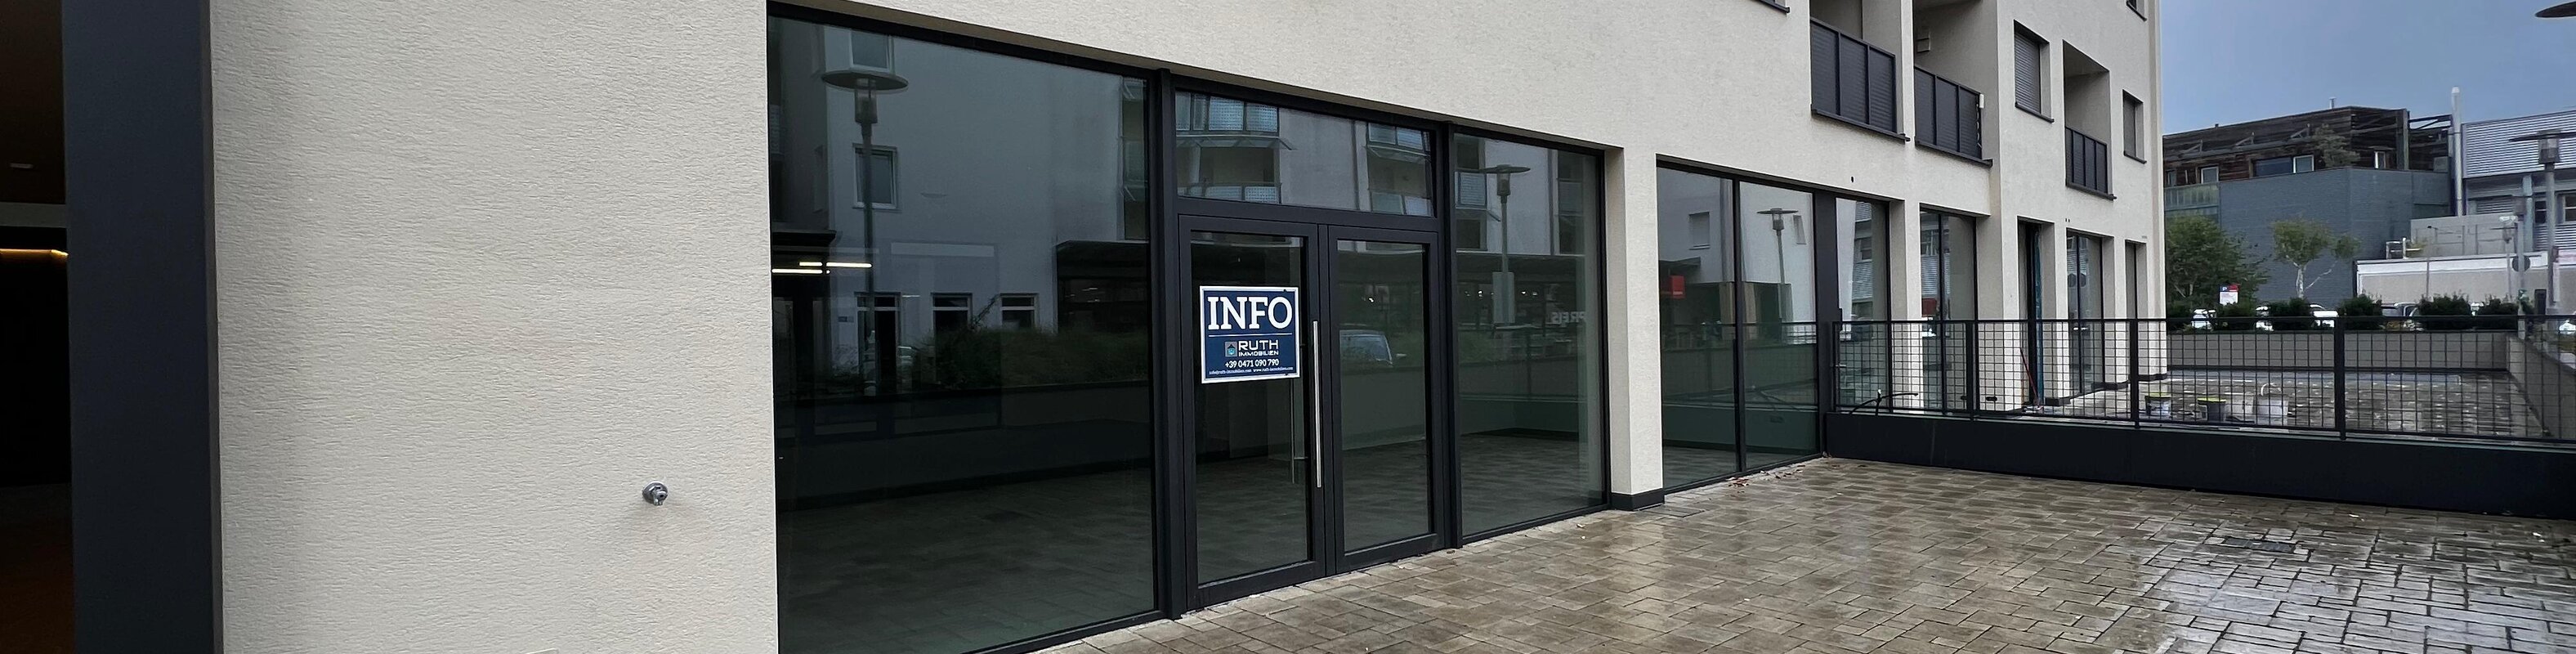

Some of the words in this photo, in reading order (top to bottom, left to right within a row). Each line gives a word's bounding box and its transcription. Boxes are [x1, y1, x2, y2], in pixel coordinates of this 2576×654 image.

[1208, 297, 1292, 329] INFO
[1238, 340, 1278, 350] RUTH
[1237, 360, 1254, 368] 0471
[1254, 359, 1267, 367] 090
[1268, 358, 1280, 366] 790
